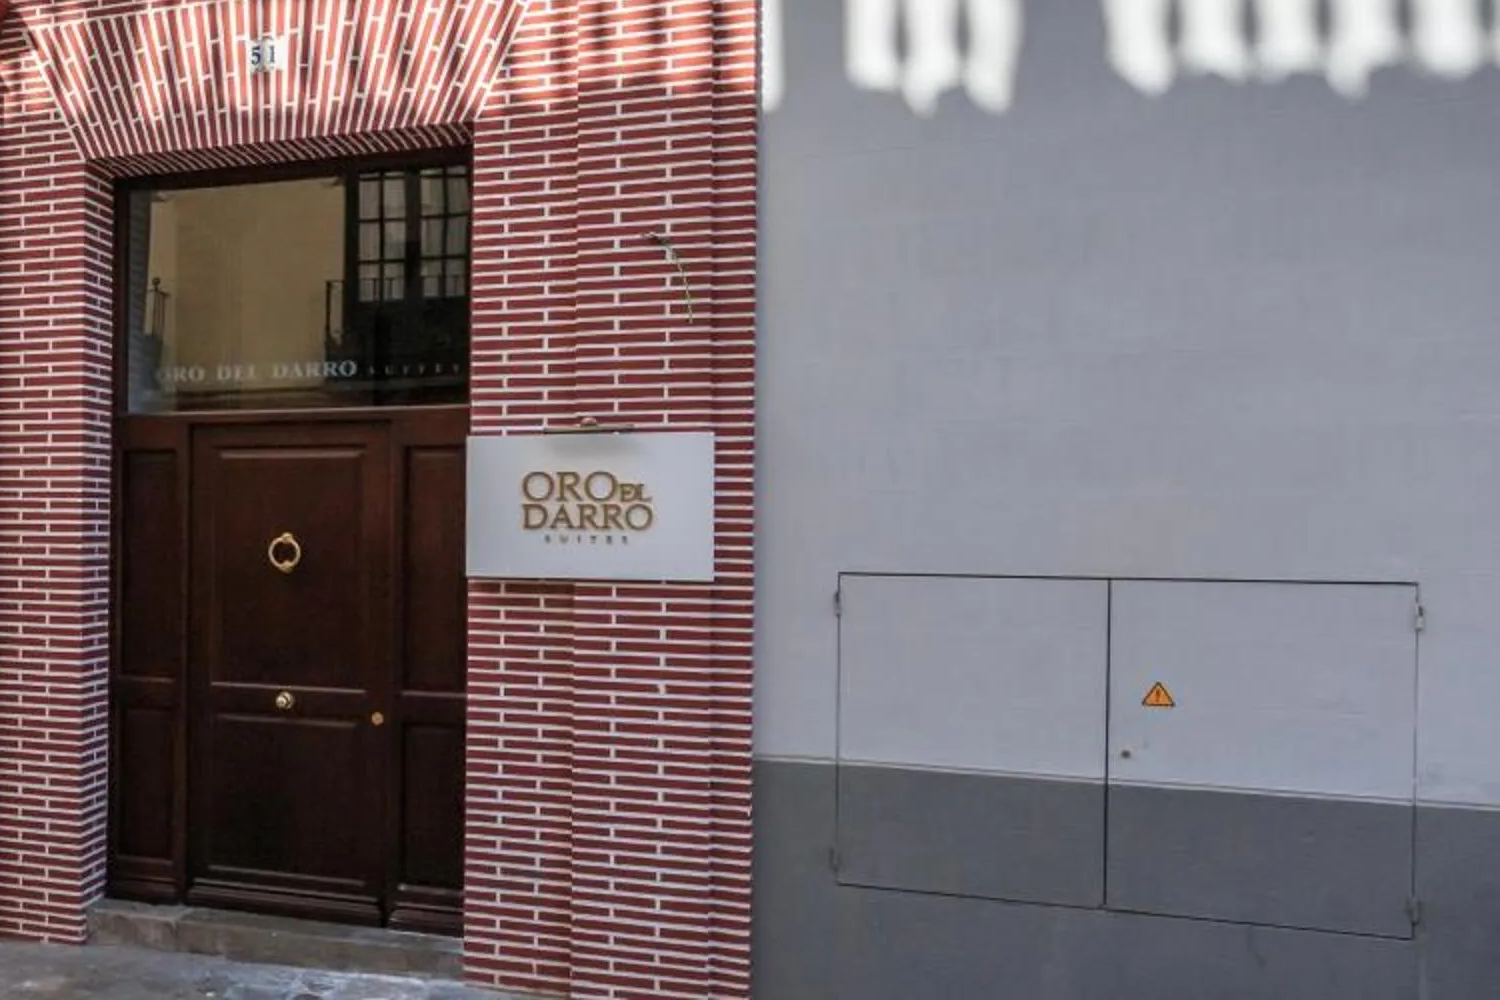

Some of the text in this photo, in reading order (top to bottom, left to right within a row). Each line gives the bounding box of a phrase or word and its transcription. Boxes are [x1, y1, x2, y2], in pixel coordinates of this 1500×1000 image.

[251, 44, 276, 66] 51
[155, 365, 205, 382] ORO
[216, 363, 257, 381] DEL
[272, 359, 358, 379] DARRO
[522, 471, 618, 502] ORO
[522, 503, 653, 531] DARRO
